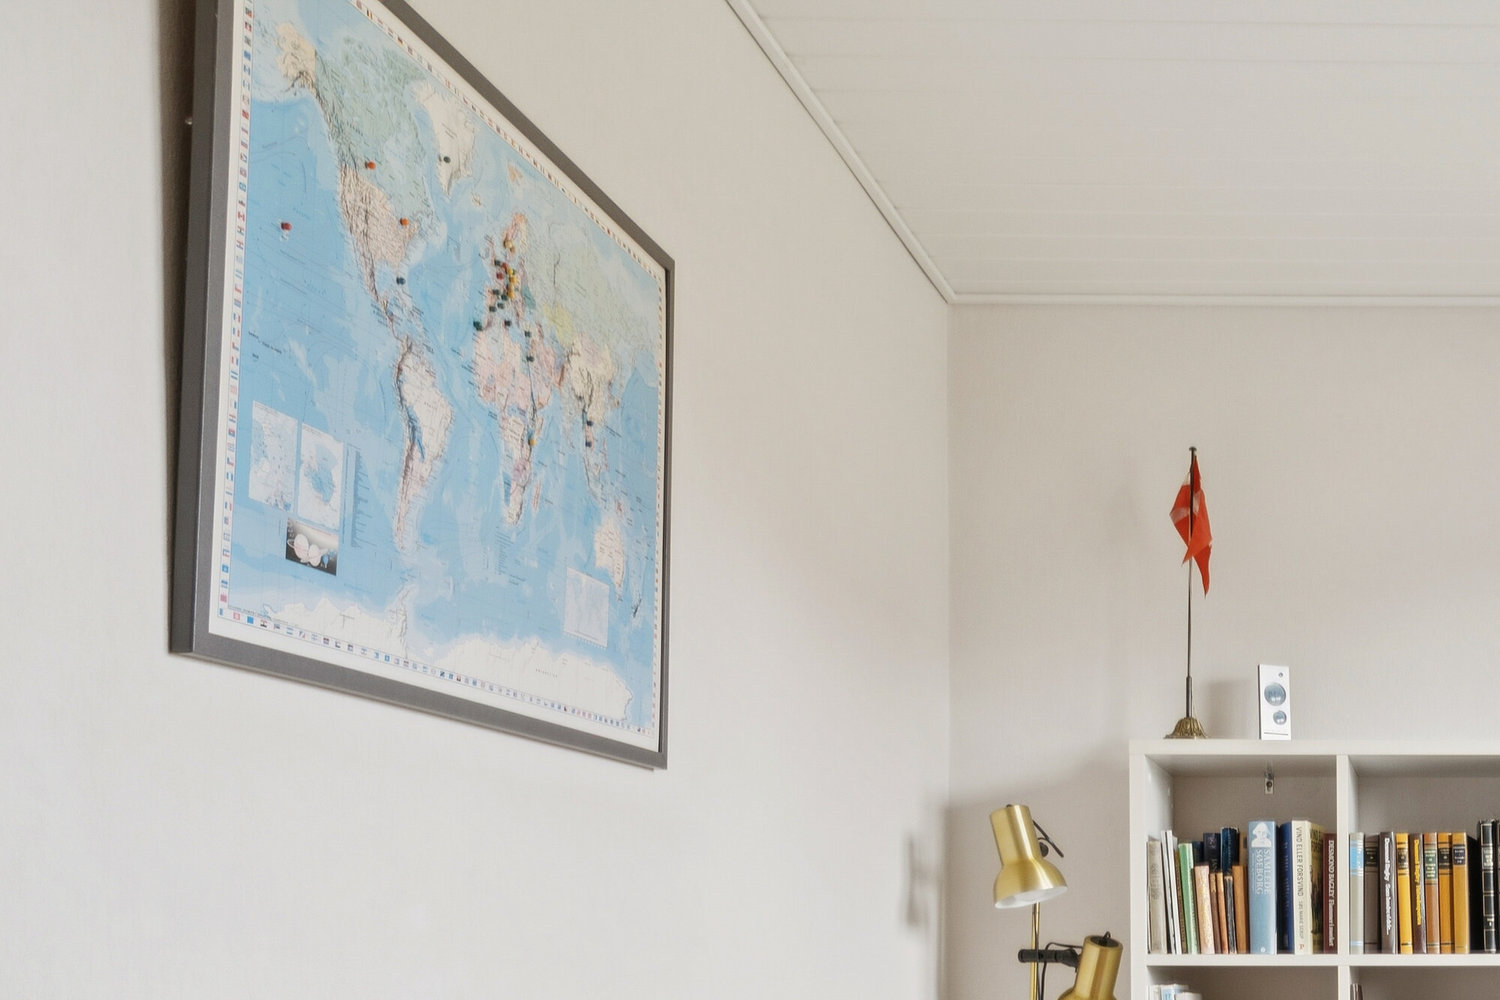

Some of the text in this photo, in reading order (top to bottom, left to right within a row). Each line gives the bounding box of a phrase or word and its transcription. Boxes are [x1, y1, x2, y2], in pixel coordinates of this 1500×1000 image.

[1295, 826, 1303, 843] VIND
[1255, 849, 1264, 895] SØEBORG
[1264, 849, 1272, 895] SAMLEDE
[1296, 864, 1304, 897] FORSVIND
